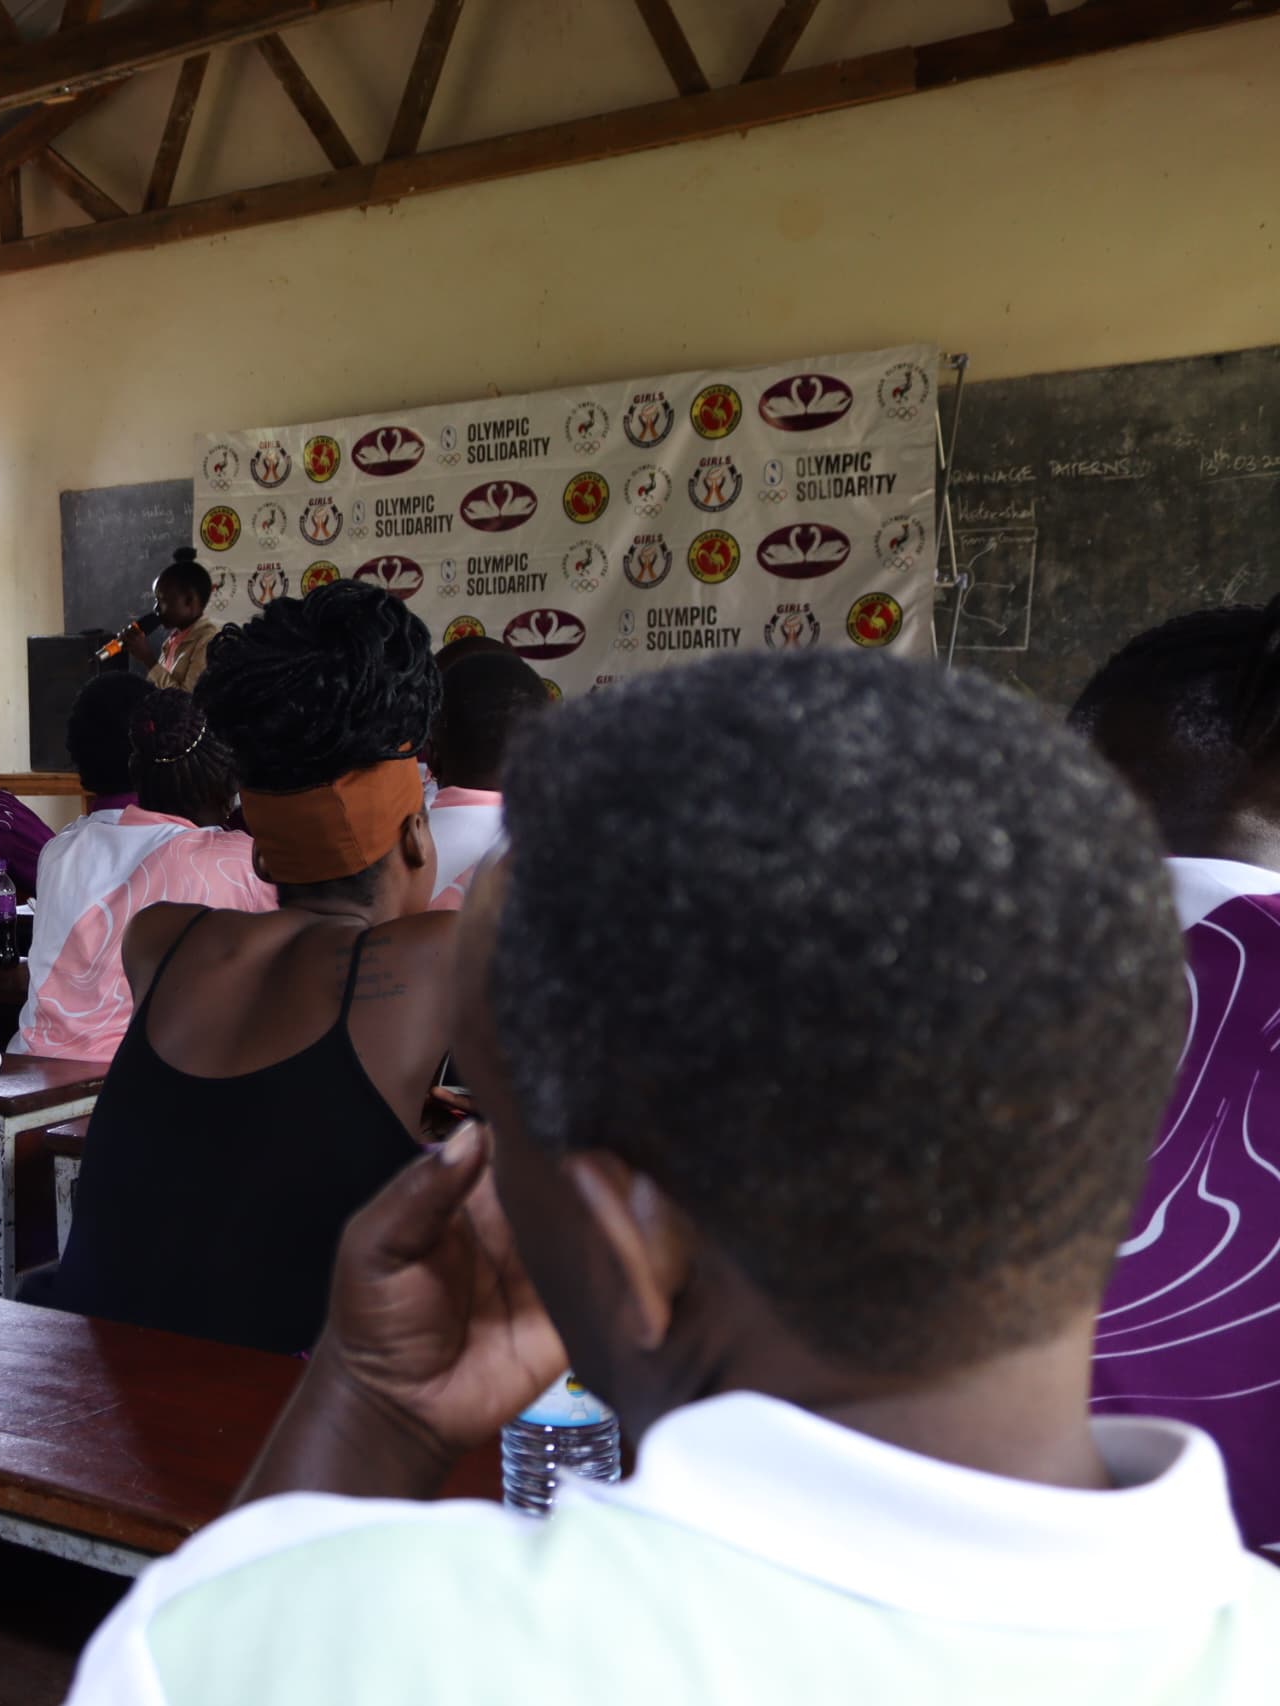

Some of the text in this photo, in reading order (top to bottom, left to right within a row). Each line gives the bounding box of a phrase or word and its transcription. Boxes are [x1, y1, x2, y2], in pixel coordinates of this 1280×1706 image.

[632, 391, 665, 405] GIRLS
[466, 417, 531, 443] OLYMPIC
[466, 437, 551, 465] SOLIDARITY
[698, 455, 732, 468] GIRLS
[795, 451, 873, 479] OLYMPIC
[795, 474, 898, 502] SOLIDARITY
[308, 497, 333, 507] GIRLS
[374, 495, 436, 518] OLYMPIC
[374, 514, 454, 538] SOLIDARITY
[633, 533, 664, 546] GIRLS
[256, 563, 282, 573] GIRLS
[466, 553, 529, 576] OLYMPIC
[466, 572, 548, 597] SOLIDARITY
[646, 606, 718, 628] OLYMPIC
[776, 603, 811, 615] GIRLS
[646, 628, 742, 652] SOLIDARITY
